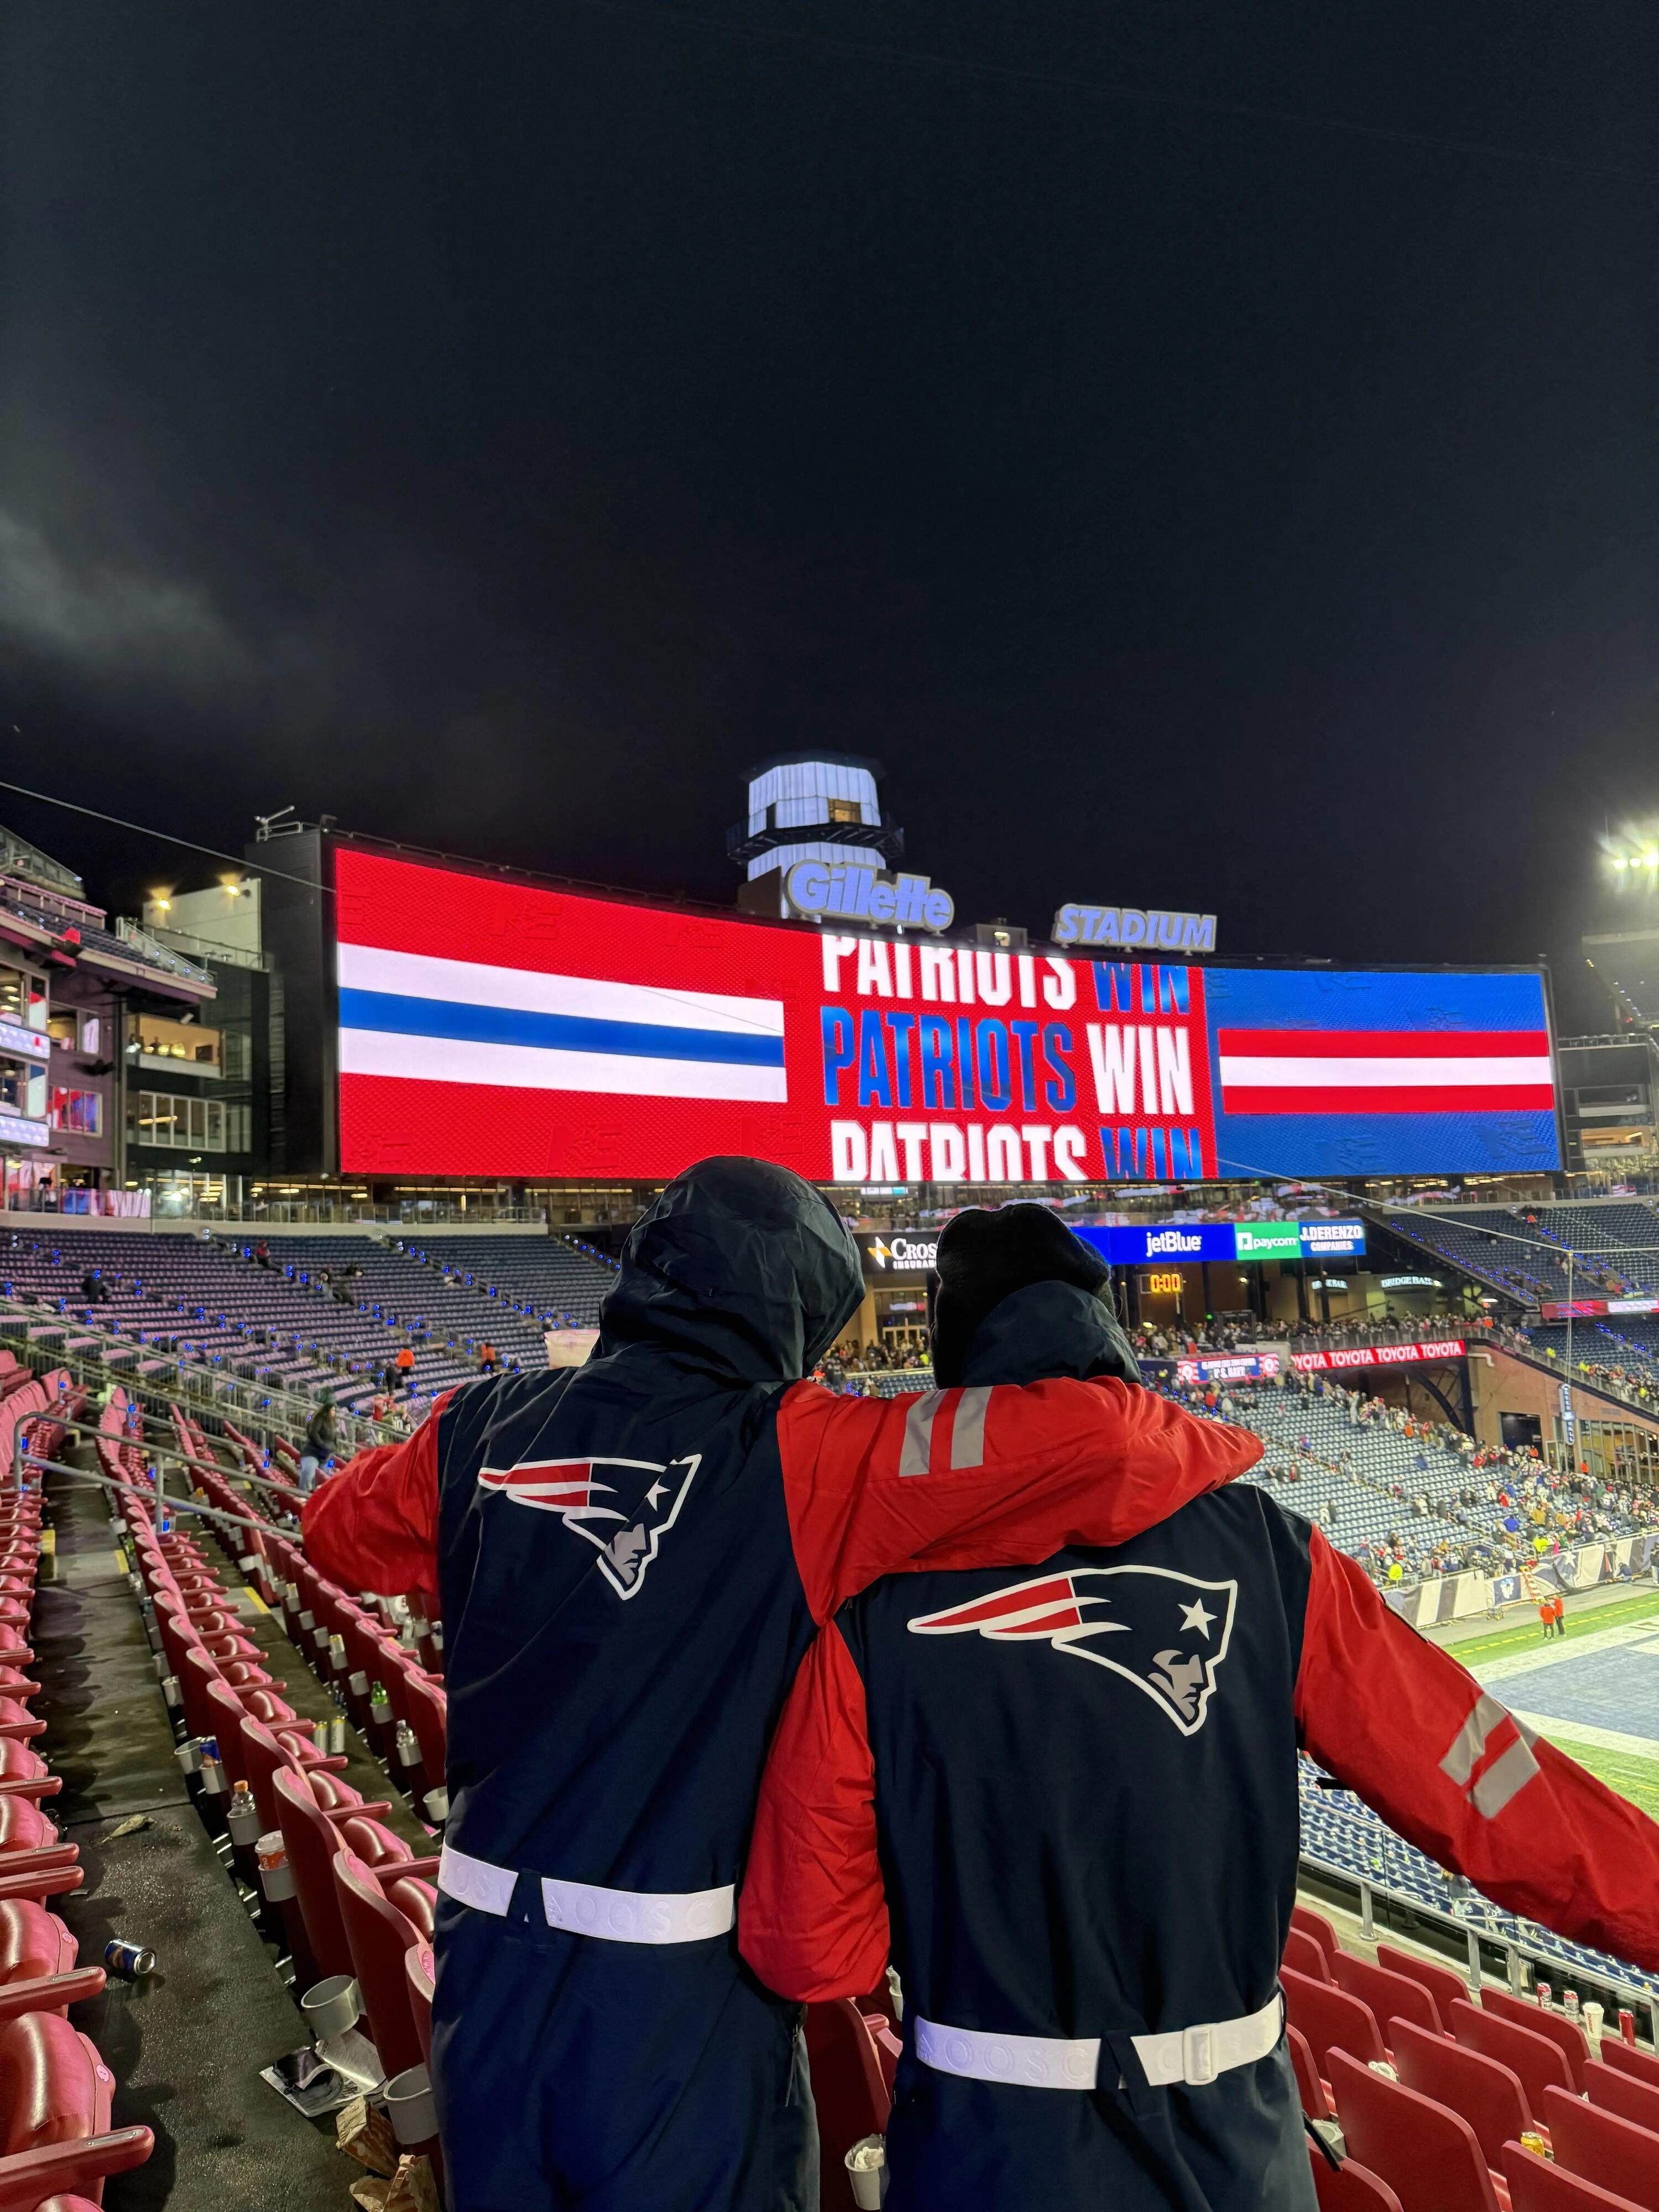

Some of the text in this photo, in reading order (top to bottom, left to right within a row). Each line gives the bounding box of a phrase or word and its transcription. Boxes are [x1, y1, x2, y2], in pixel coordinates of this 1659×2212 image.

[791, 862, 952, 928] Gillette
[1058, 907, 1214, 948] STADIUM
[821, 1006, 1194, 1115] PATRIOTS WIN
[890, 1238, 937, 1261] CROS
[1146, 1231, 1202, 1257] jetBlue
[1253, 1237, 1297, 1250] paycom
[893, 1259, 937, 1270] INSURAN
[1150, 1274, 1181, 1293] 0:00
[1291, 1342, 1462, 1370] YOTA TOYOTA TOYOTA TOYOTA
